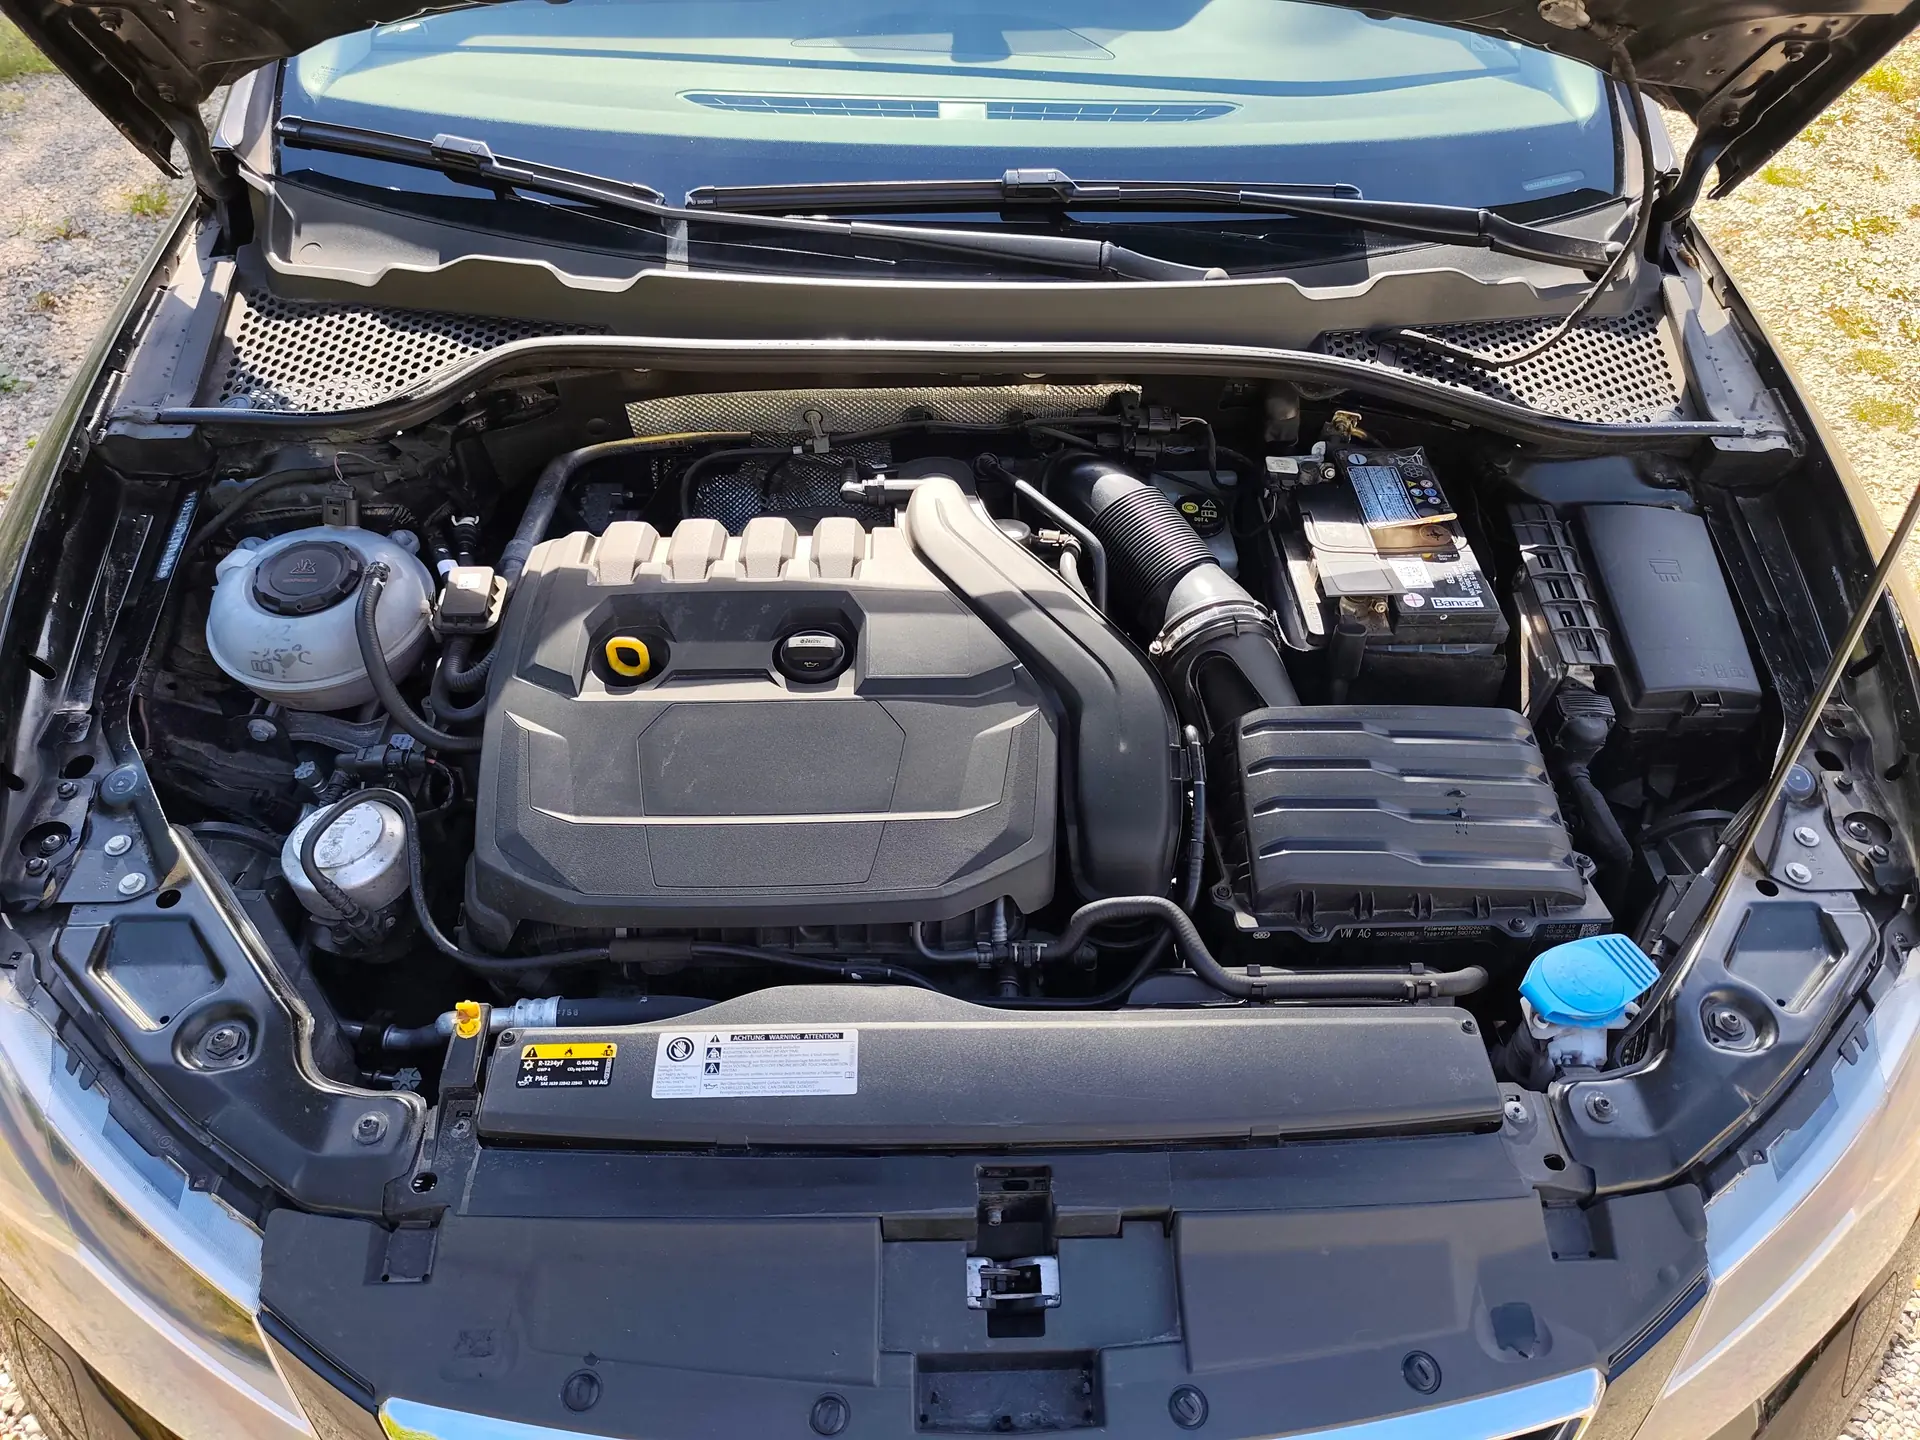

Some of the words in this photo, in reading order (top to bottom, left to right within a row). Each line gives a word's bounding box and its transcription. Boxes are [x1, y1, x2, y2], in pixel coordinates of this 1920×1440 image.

[1443, 572, 1456, 584] EFB
[1433, 599, 1479, 607] Banner
[1339, 928, 1354, 938] VW
[1357, 928, 1372, 938] AG
[537, 1060, 564, 1068] R-1234yf
[592, 1059, 600, 1067] kg
